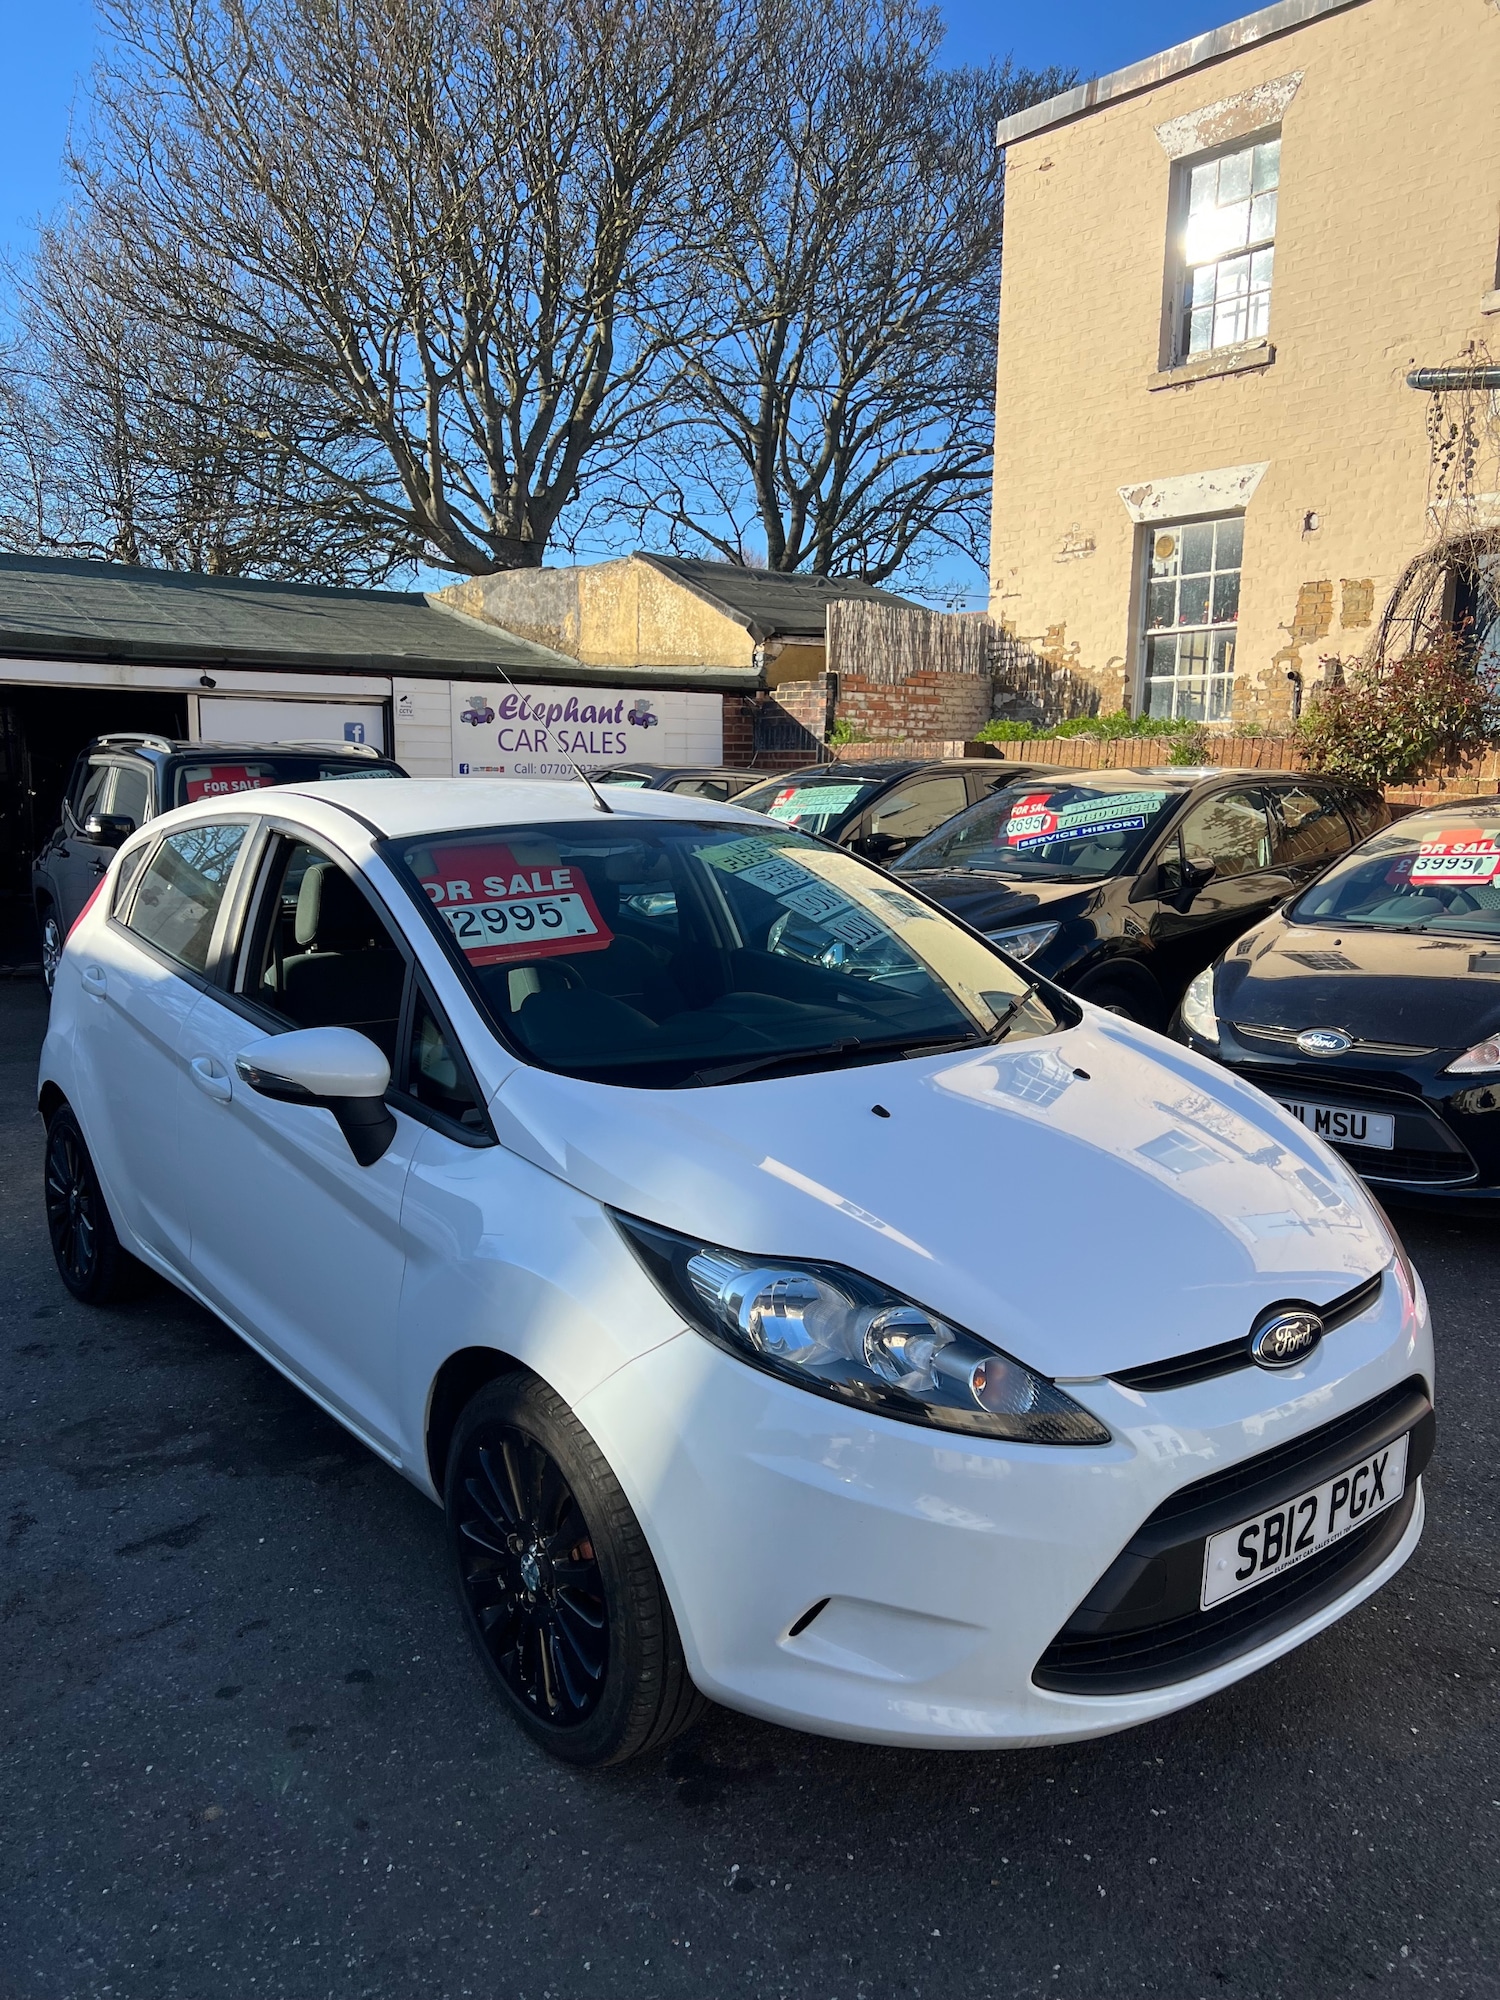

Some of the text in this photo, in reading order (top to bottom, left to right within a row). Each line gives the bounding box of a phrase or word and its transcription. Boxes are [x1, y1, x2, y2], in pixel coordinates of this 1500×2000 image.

[499, 694, 624, 728] Elephant
[498, 728, 627, 754] CAR SALES
[514, 763, 536, 774] Call:
[204, 780, 260, 792] FOR SALE
[1011, 806, 1029, 815] FOR
[1108, 801, 1157, 818] DIESEL
[1007, 816, 1042, 833] 3695
[1021, 820, 1140, 847] SERVICE HISTORY
[1420, 843, 1447, 854] OR
[1416, 857, 1474, 870] 3995
[422, 868, 574, 903] OR SALE
[453, 902, 563, 938] 2995
[1308, 1033, 1337, 1049] Ford
[1315, 1108, 1367, 1140] MSU
[1275, 1321, 1313, 1357] Ford
[1235, 1451, 1389, 1581] SB12 PGX
[1274, 1555, 1303, 1574] ELEPHANT
[1303, 1547, 1314, 1559] CAR
[1314, 1538, 1330, 1552] SALES
